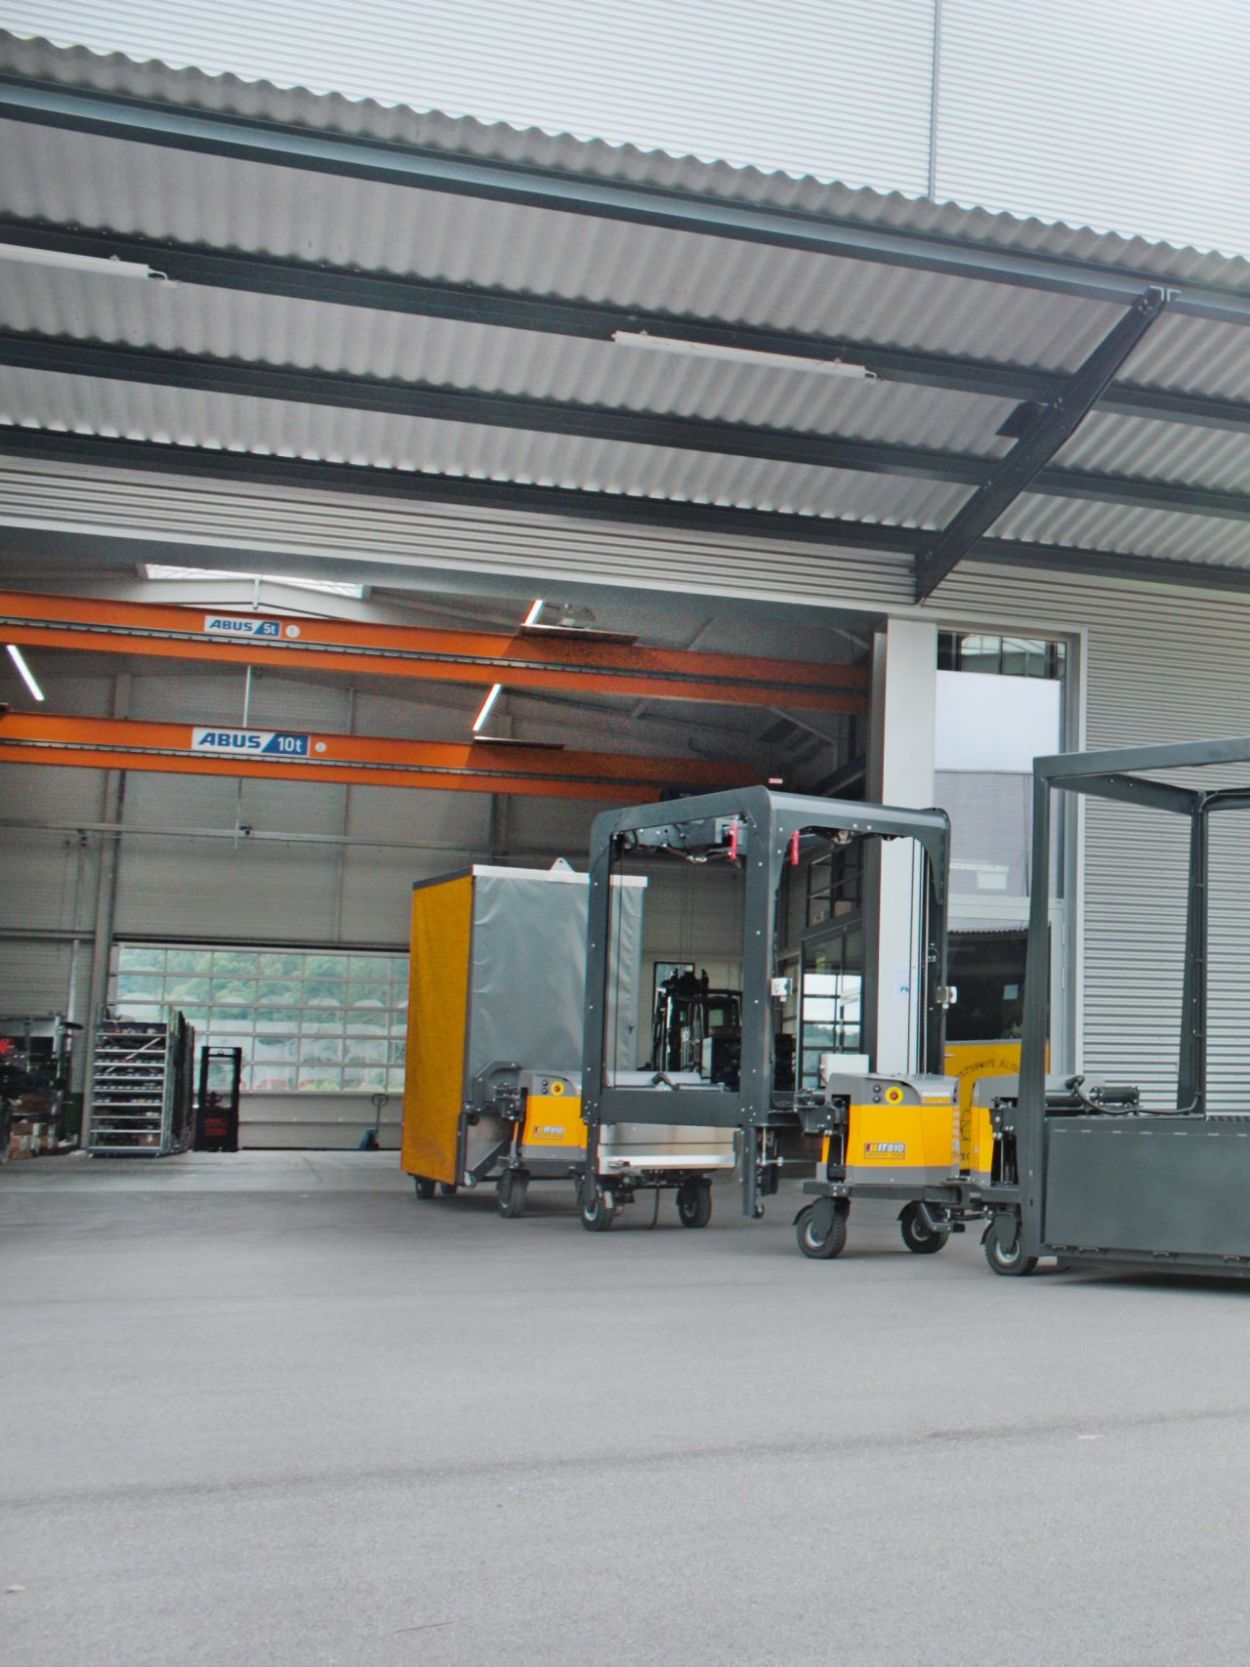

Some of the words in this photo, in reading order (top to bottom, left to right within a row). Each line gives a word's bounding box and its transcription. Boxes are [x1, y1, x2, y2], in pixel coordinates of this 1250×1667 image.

[209, 619, 253, 632] ABUS
[263, 623, 277, 635] 5t
[198, 732, 261, 749] ABUS
[277, 737, 303, 753] 10t
